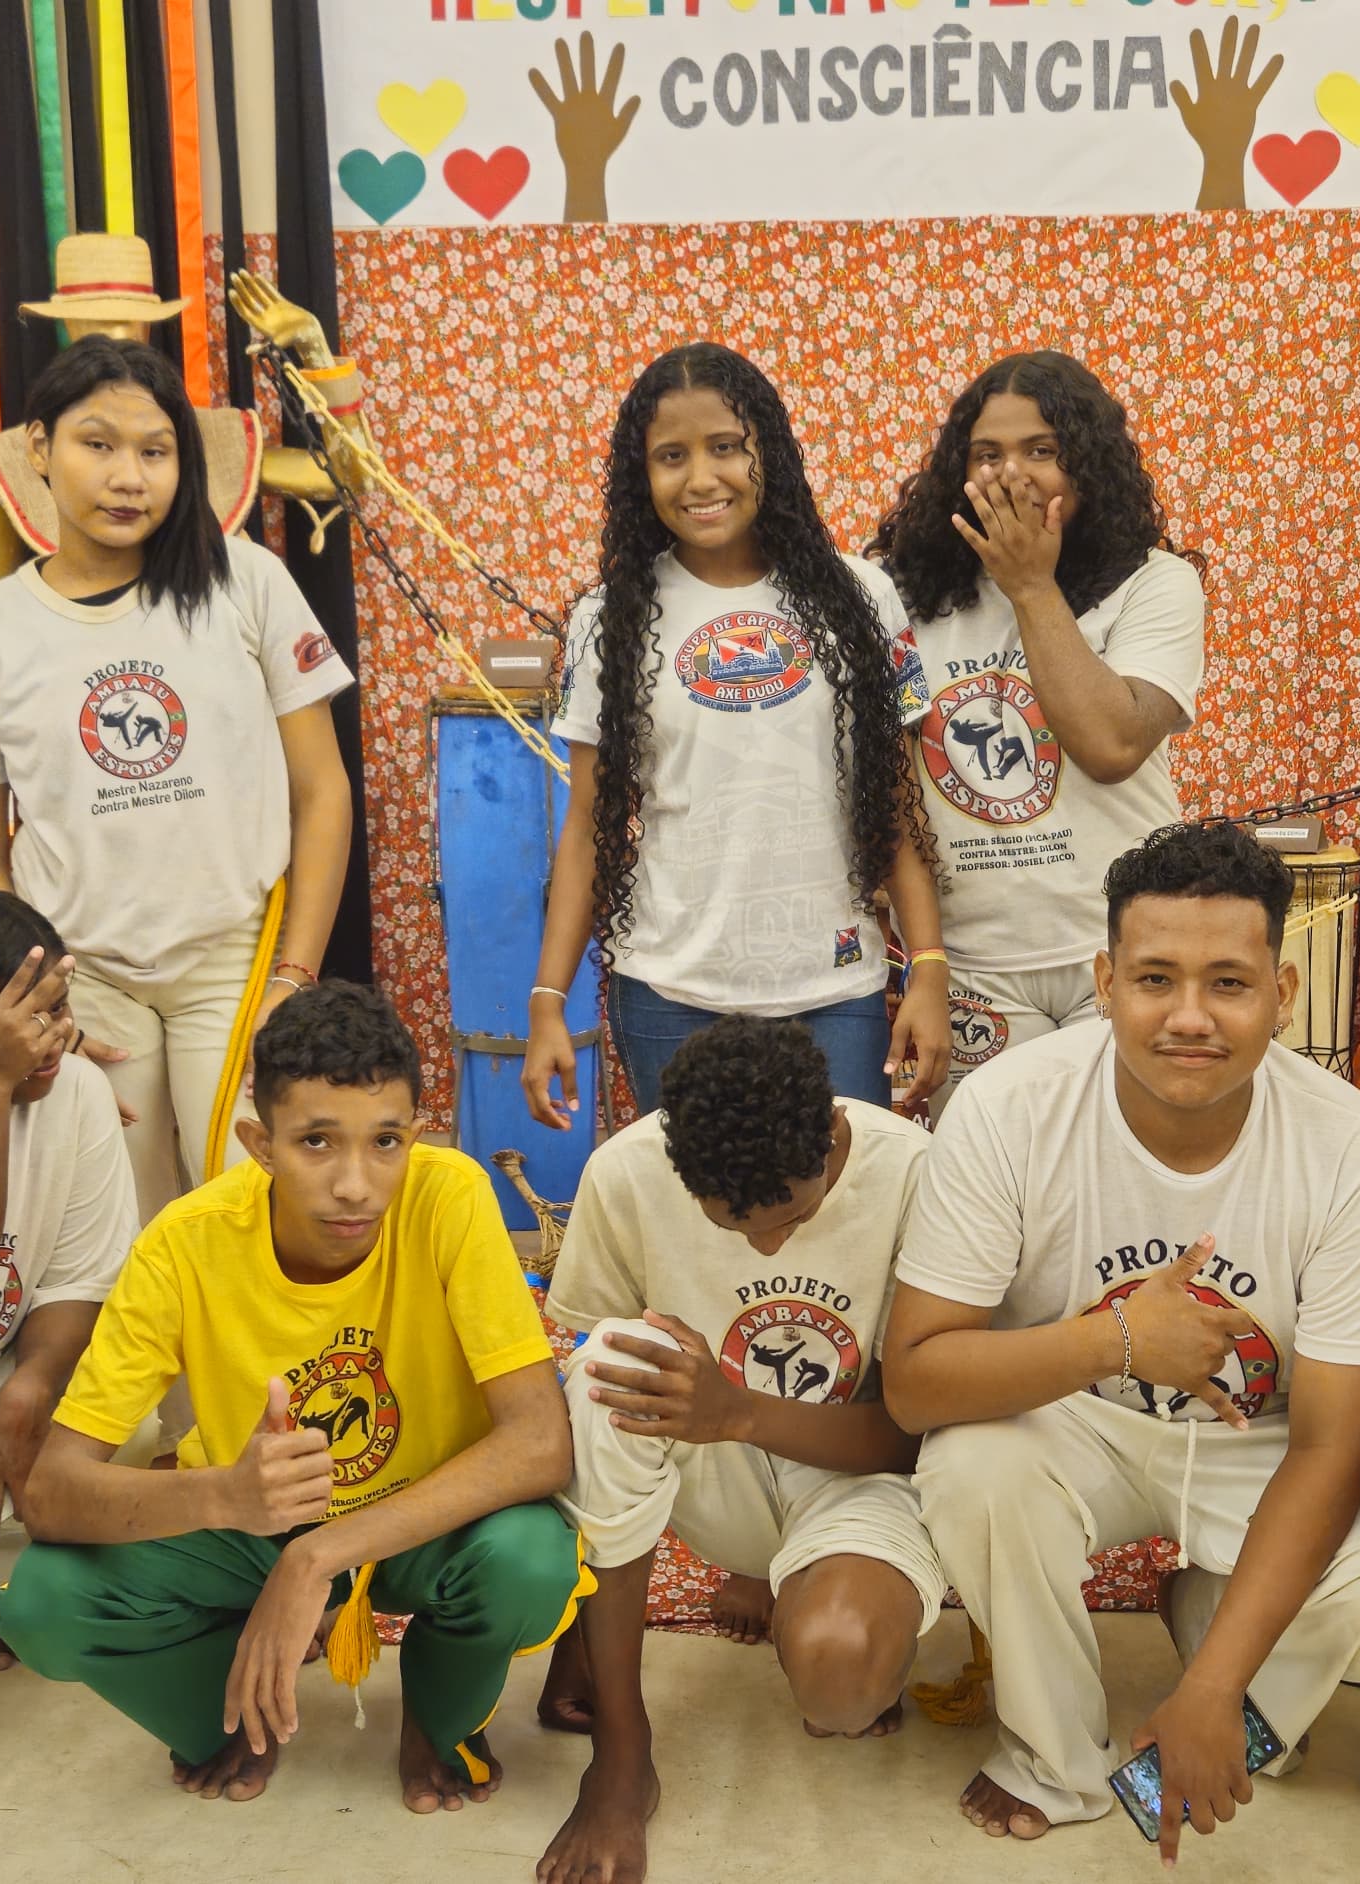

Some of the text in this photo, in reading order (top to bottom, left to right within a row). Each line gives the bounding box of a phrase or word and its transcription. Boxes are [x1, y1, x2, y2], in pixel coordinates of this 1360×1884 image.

[659, 22, 1168, 129] CONSCIÊNCIA
[678, 614, 808, 674] GRUPO DE CAPOEIRA
[83, 660, 165, 690] PROJETO
[746, 678, 785, 700] DUDU
[87, 677, 171, 714] AMBAJU
[92, 732, 184, 778] ESPORTES
[97, 775, 193, 801] Mestre Nazareno
[937, 759, 1057, 821] ESPORTES
[91, 796, 130, 816] Contra
[132, 792, 172, 809] Mestre
[949, 838, 989, 849] MESTRE:
[991, 834, 1023, 846] SÉRGIO
[959, 842, 1068, 860] CONTRA MESTRE: DILON
[955, 852, 1075, 872] PROFESSOR: JOSIEL (ZICO)
[948, 990, 992, 1006] OJETO
[951, 1034, 1006, 1063] SPORTES
[735, 1275, 852, 1312] PROJETO
[738, 1306, 853, 1347] AMBAJU
[329, 1424, 395, 1482] ORTES
